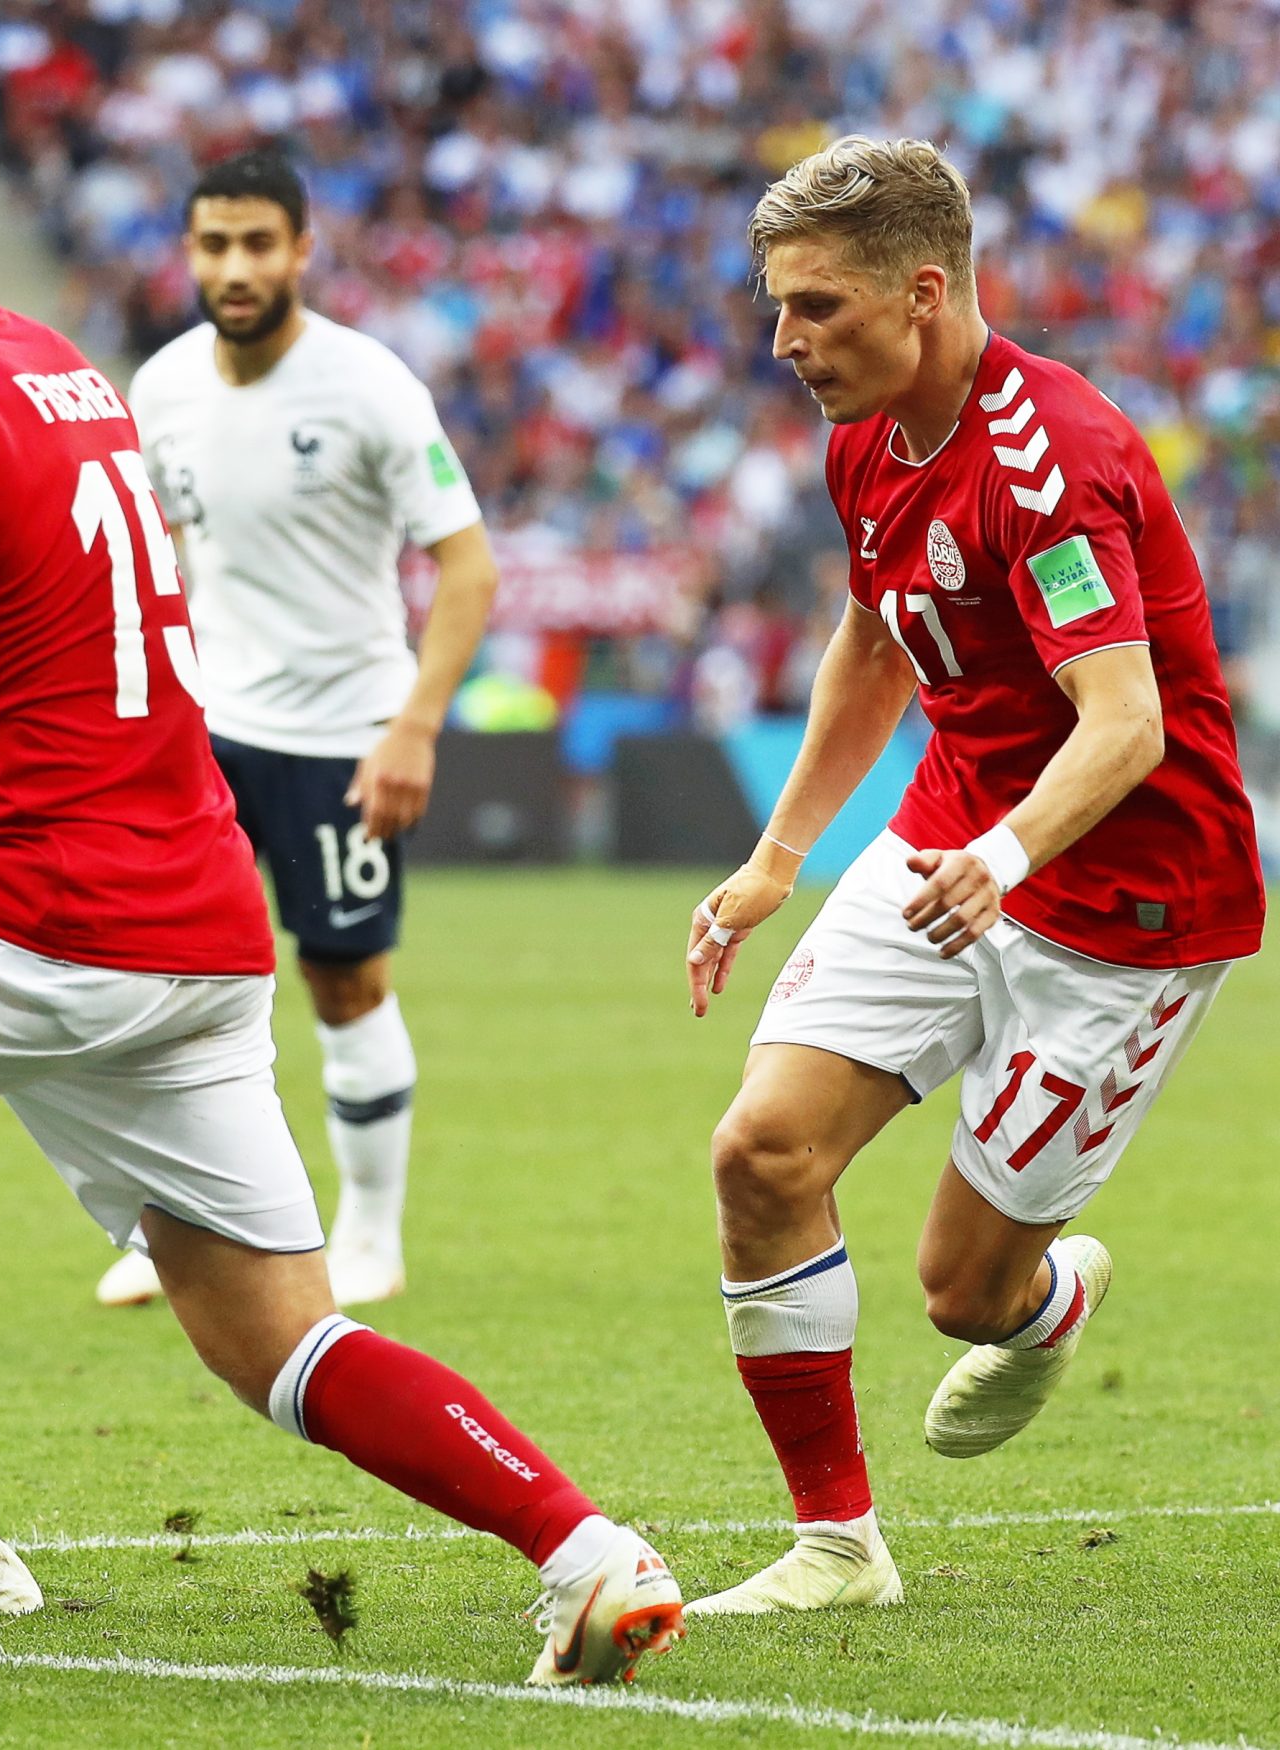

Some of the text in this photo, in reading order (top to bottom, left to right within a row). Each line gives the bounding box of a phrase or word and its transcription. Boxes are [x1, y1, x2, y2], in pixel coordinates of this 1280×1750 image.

[1042, 558, 1092, 585] LIVING
[879, 589, 964, 686] 17
[314, 821, 391, 901] 18
[973, 1050, 1087, 1173] 17
[445, 1403, 541, 1482] DANMARK
